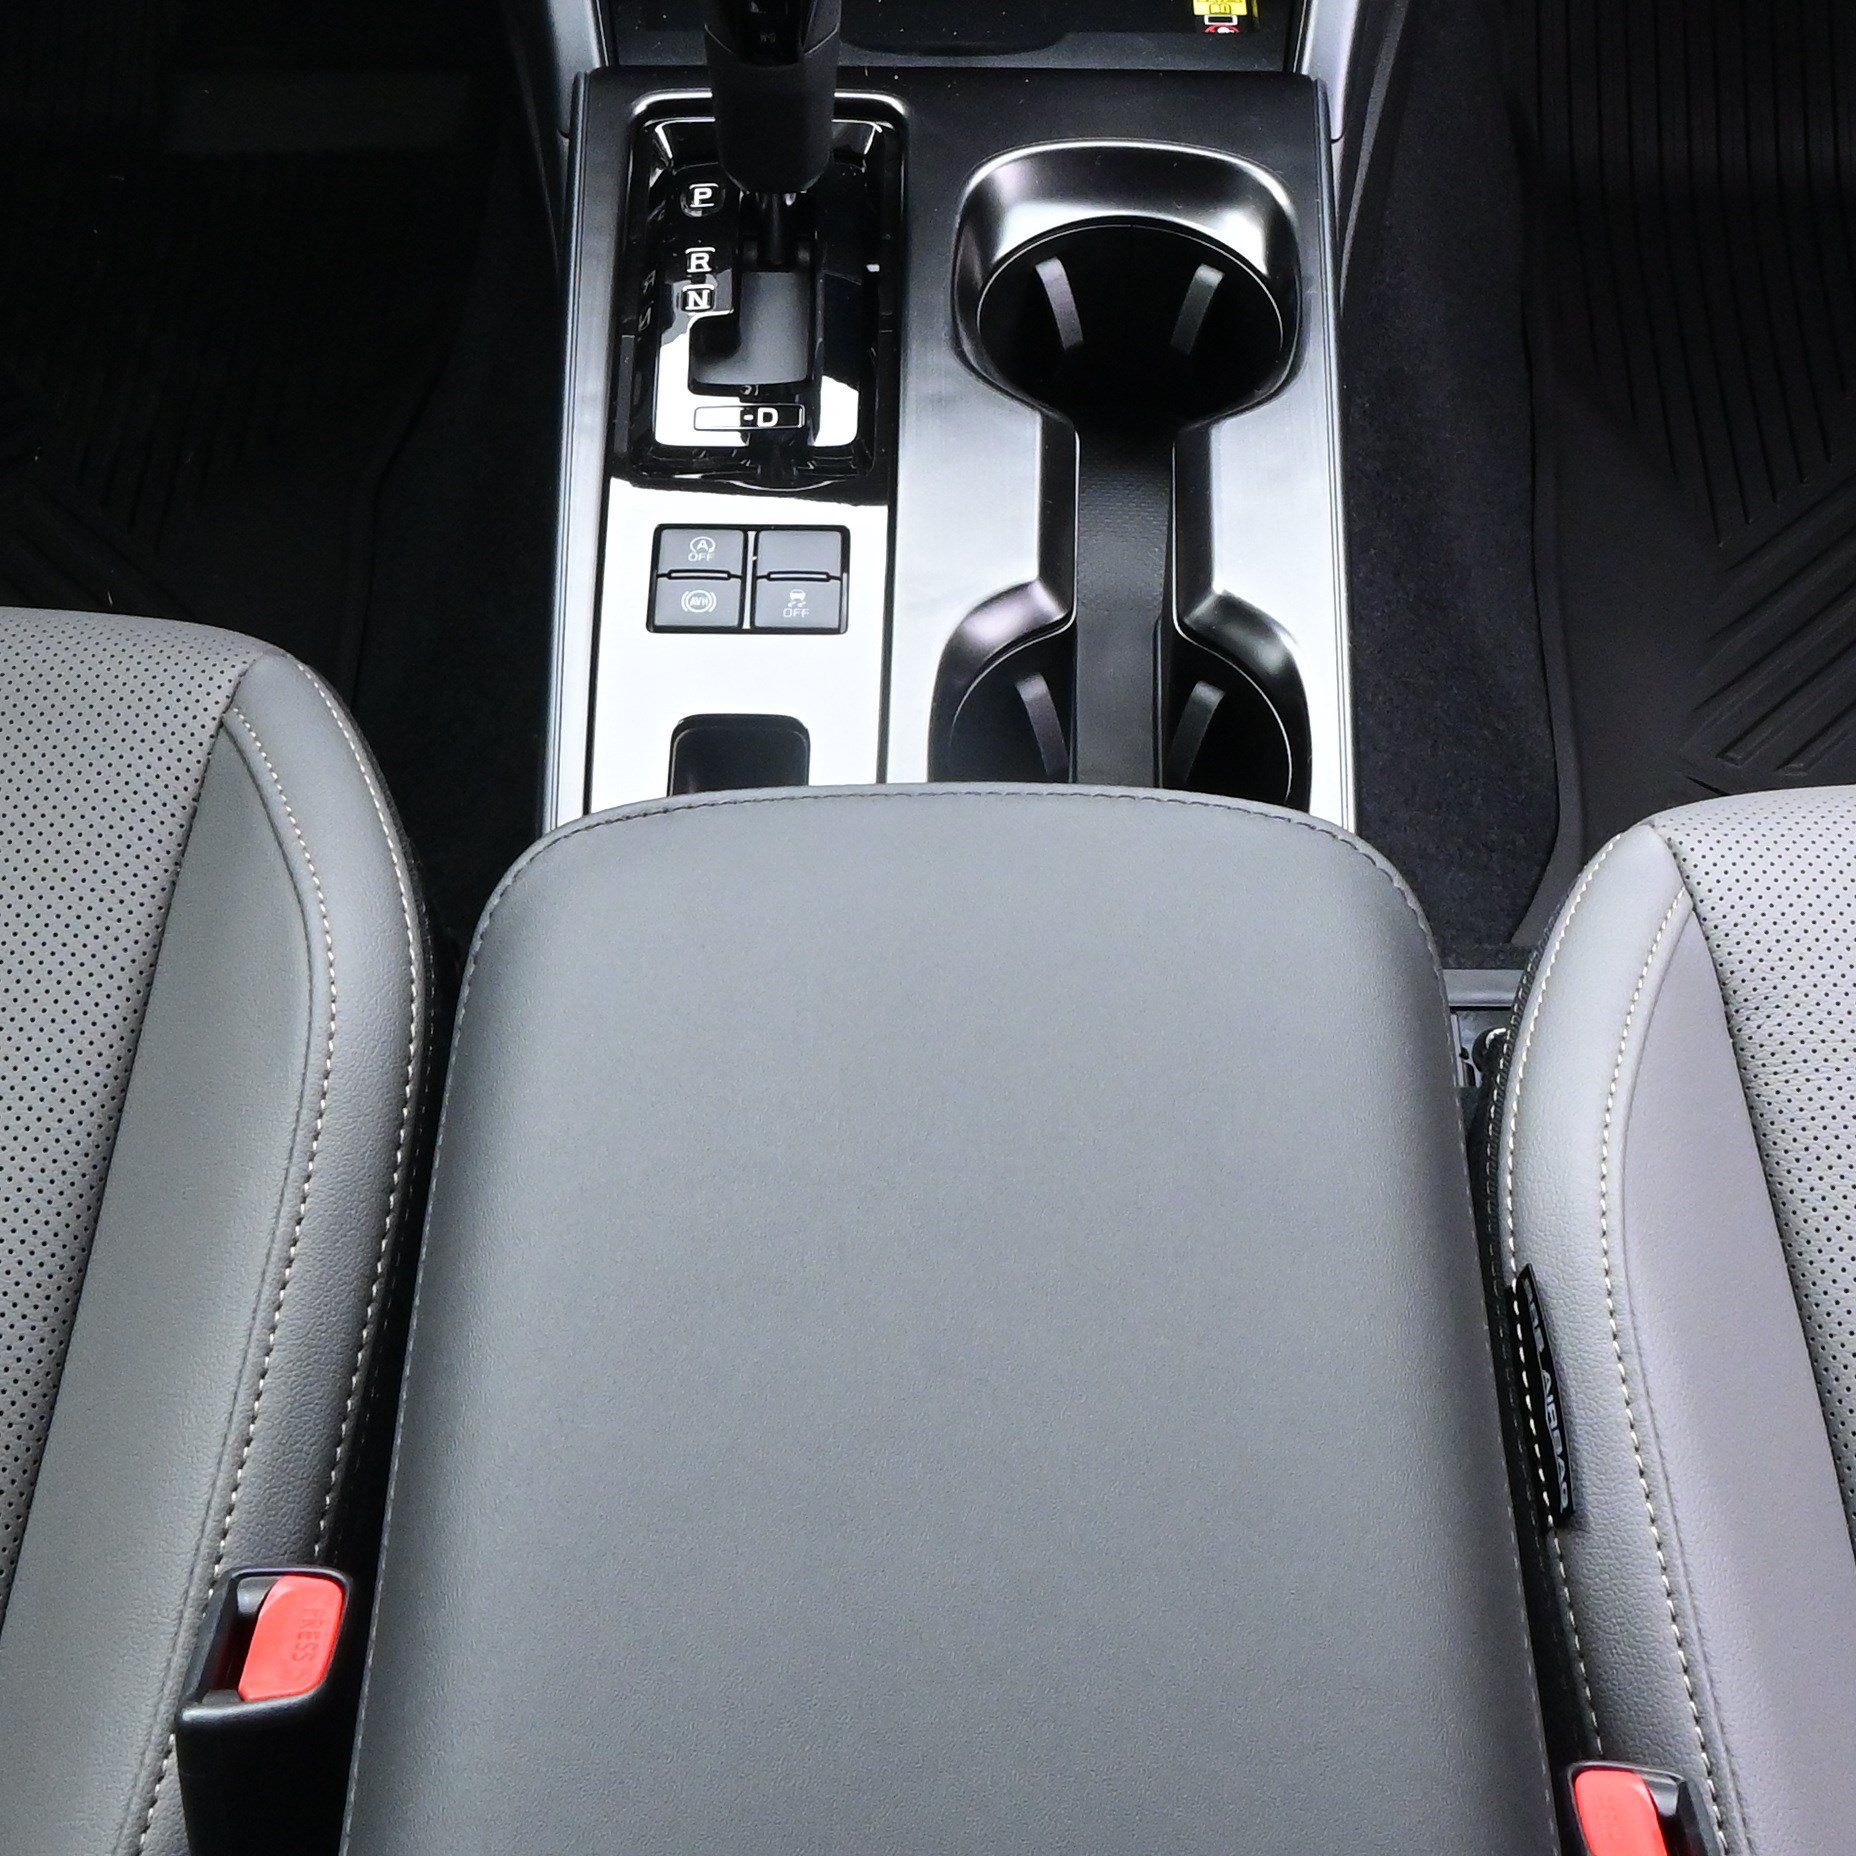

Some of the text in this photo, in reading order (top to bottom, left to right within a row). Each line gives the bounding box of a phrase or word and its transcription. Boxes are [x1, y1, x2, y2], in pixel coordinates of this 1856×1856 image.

[692, 187, 714, 207] P
[690, 253, 712, 272] R
[687, 291, 711, 309] N
[756, 407, 779, 427] D
[782, 608, 809, 618] OFF
